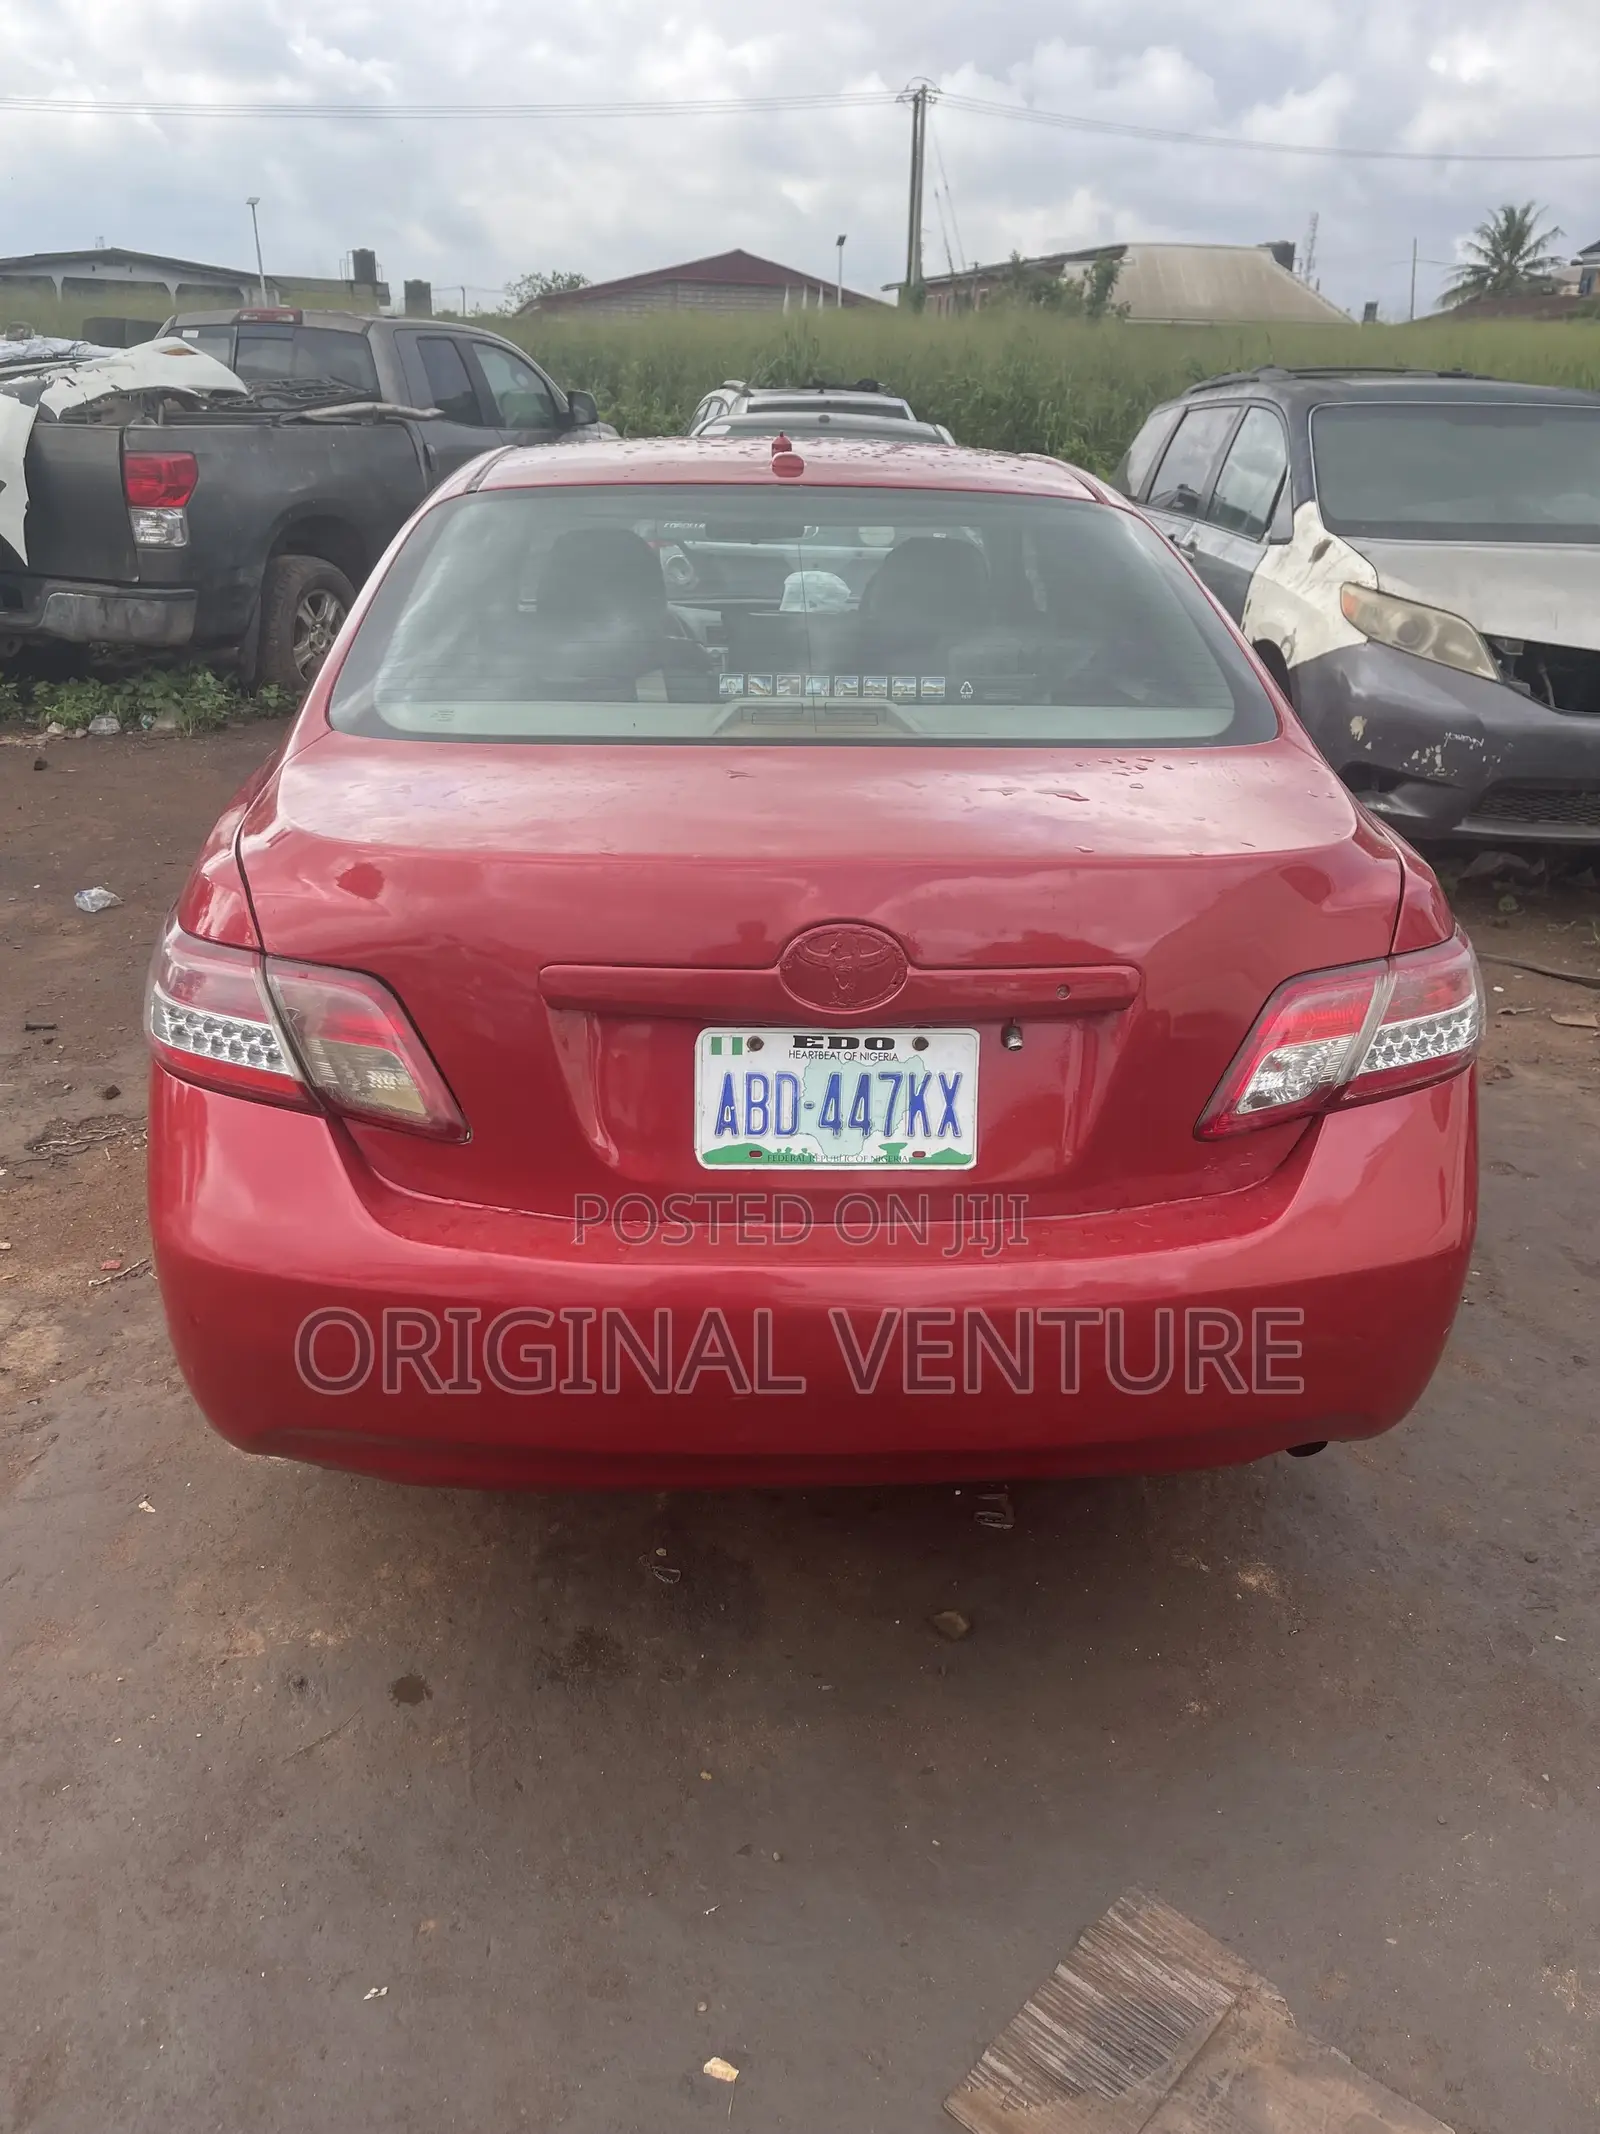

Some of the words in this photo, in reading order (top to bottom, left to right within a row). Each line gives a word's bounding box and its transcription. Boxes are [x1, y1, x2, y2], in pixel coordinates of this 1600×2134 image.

[793, 1035, 895, 1050] EDO
[788, 1050, 841, 1060] HEARTBEAT
[843, 1051, 858, 1061] OF
[859, 1052, 899, 1062] NIGERIA
[714, 1071, 962, 1137] ABD-447KX
[767, 1154, 807, 1163] FEDERAL
